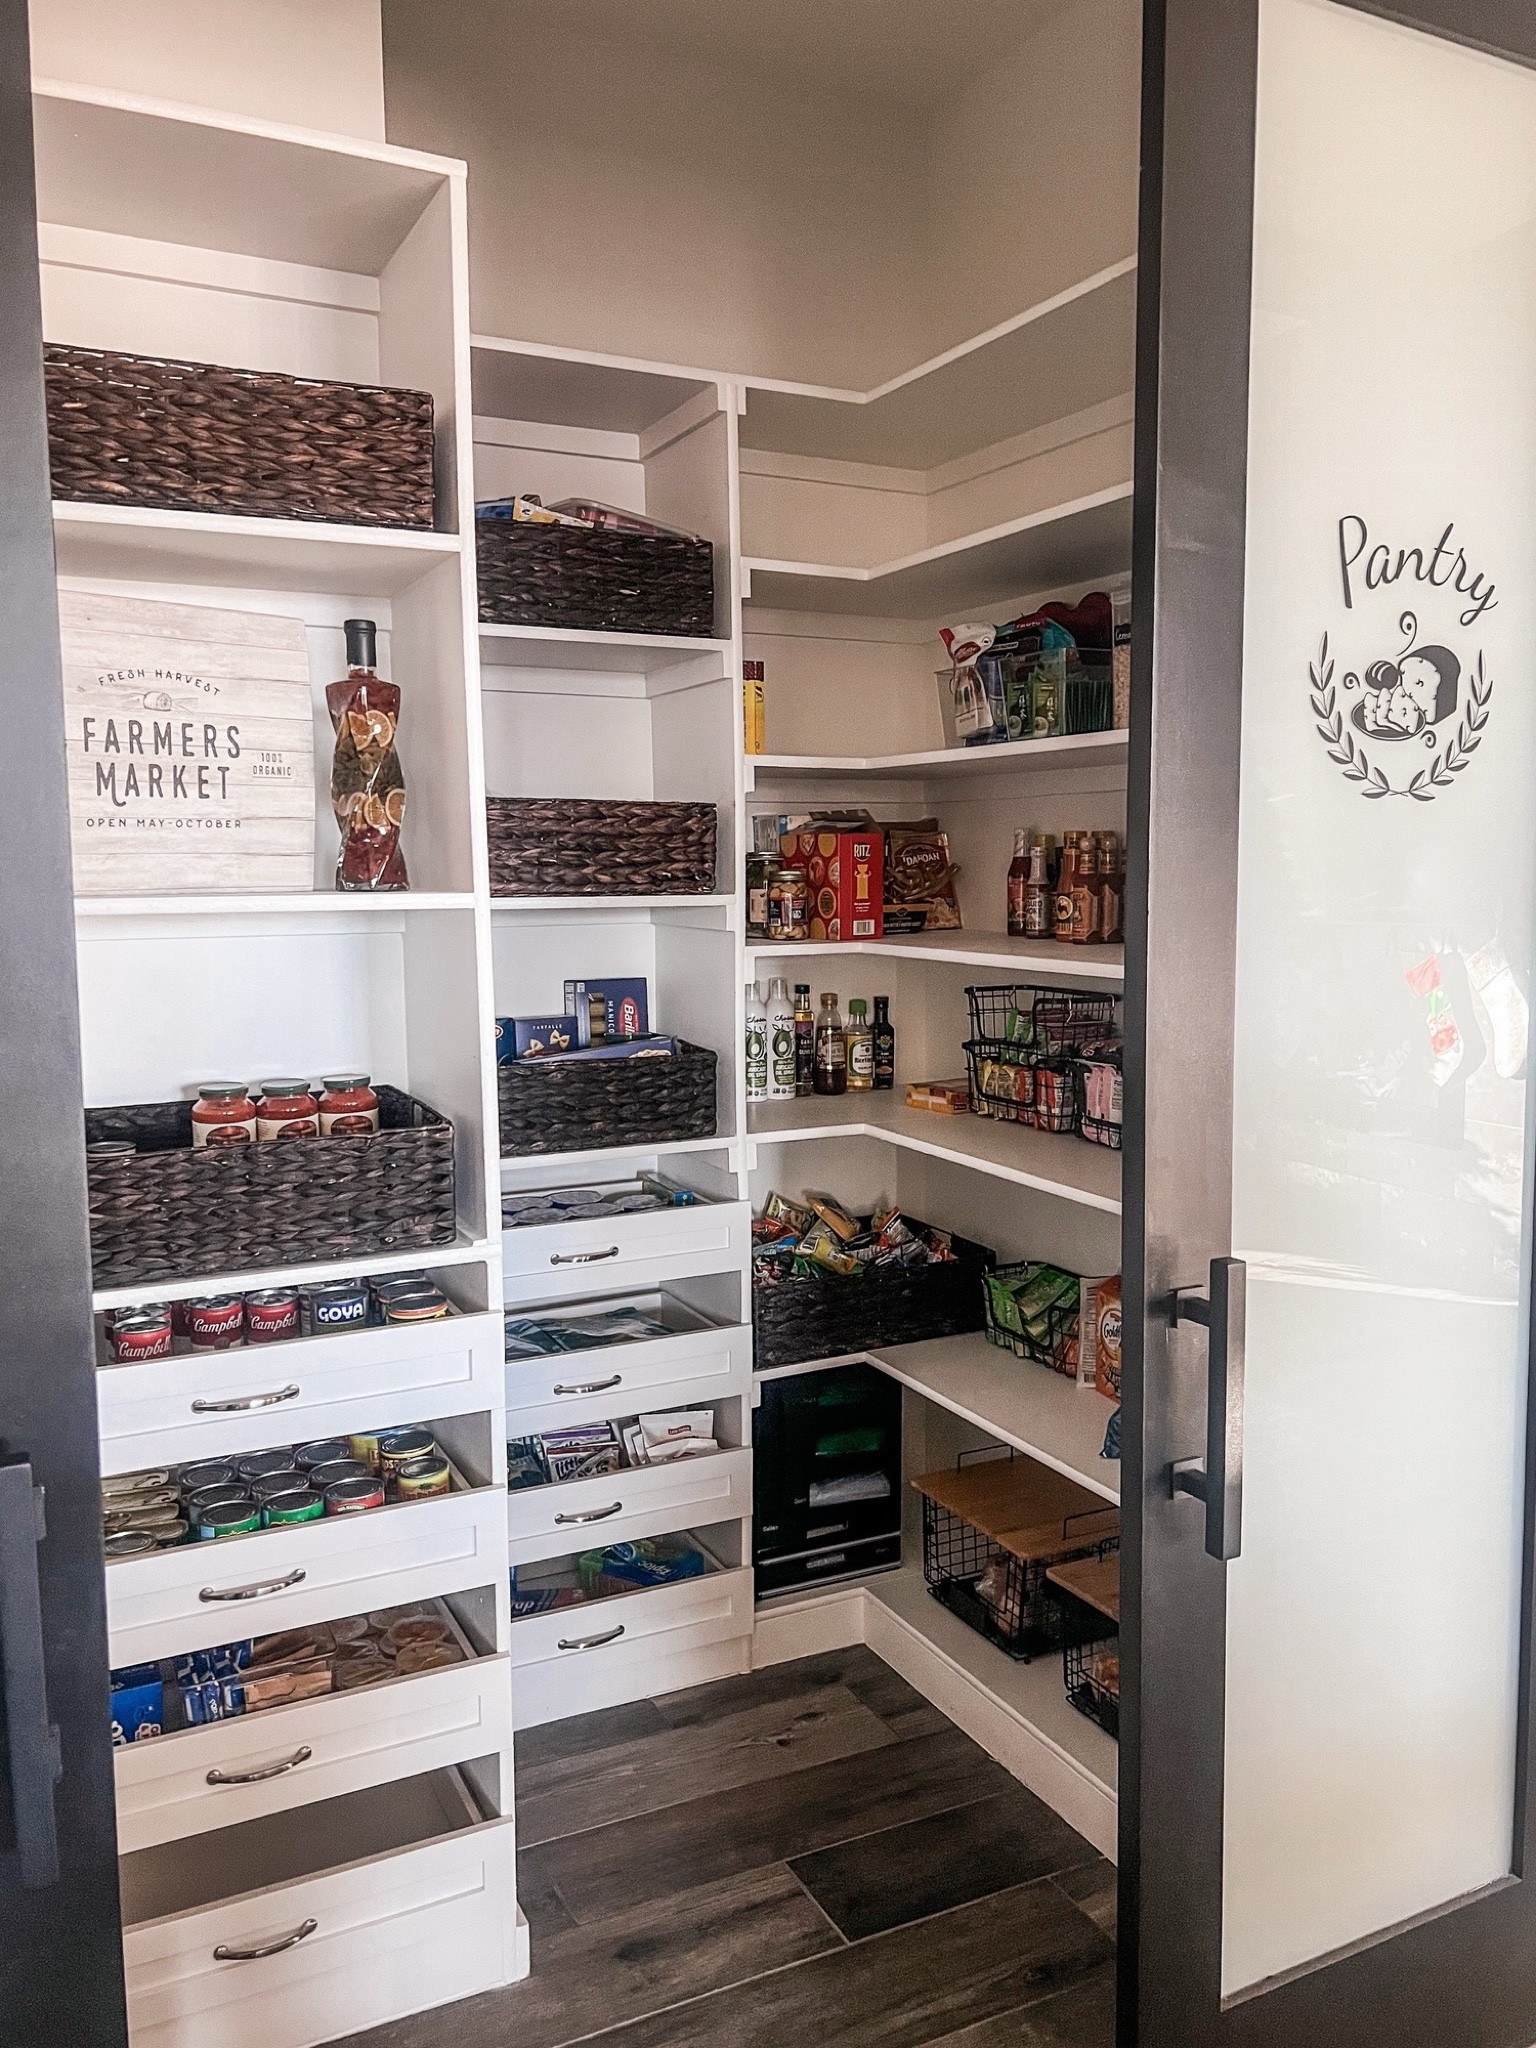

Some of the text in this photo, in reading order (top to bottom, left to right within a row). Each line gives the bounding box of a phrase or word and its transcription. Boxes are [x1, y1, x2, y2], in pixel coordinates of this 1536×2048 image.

[1338, 515, 1499, 626] Pantry
[98, 668, 221, 696] FRESH HARVEST
[82, 717, 241, 759] FARMERS
[261, 752, 283, 763] 100%
[252, 765, 292, 776] ORGANIC
[95, 761, 231, 807] MARKET
[86, 816, 127, 828] OPEN
[853, 844, 871, 858] RITZ
[607, 1000, 615, 1034] MANICO
[318, 1303, 364, 1323] GOYA
